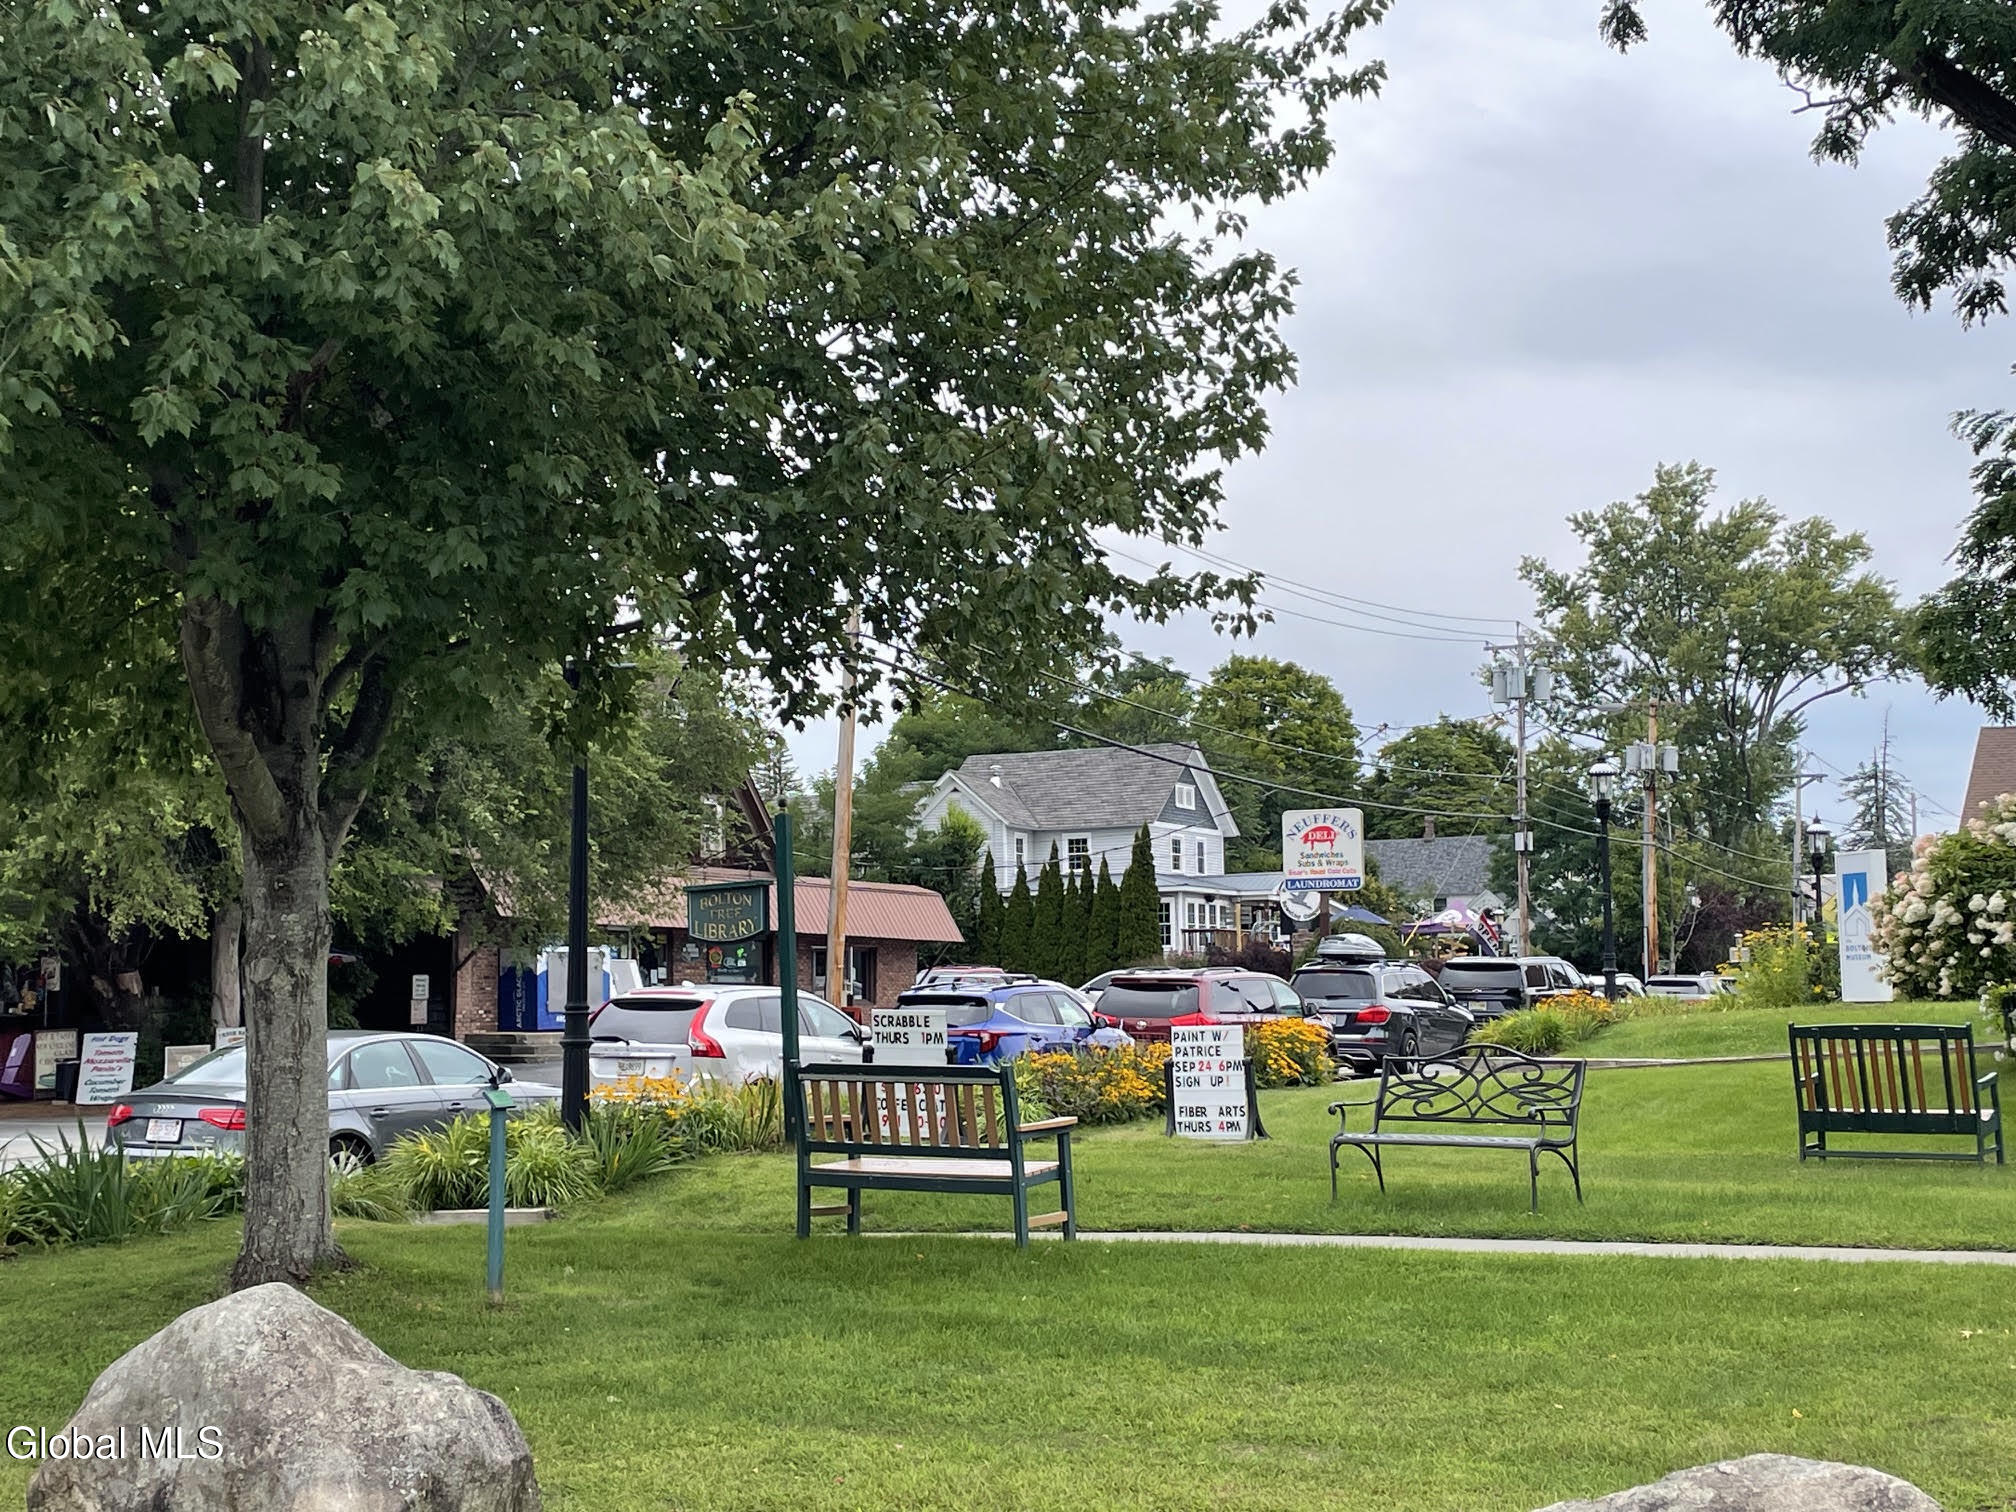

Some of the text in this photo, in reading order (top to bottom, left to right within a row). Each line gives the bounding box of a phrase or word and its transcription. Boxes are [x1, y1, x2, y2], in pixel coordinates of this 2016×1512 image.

[1308, 830, 1335, 840] DELI
[1300, 851, 1344, 859] Sandwiches
[1326, 860, 1349, 868] Wraps
[1287, 878, 1360, 889] LAUNDROMAT
[700, 891, 752, 910] BOLTON
[710, 907, 742, 920] FREE
[694, 918, 755, 940] LIBRARY
[873, 1015, 930, 1028] SCRABBLE
[875, 1032, 944, 1044] THURS 1PM
[1173, 1031, 1229, 1042] PAINT W/
[1175, 1046, 1221, 1057] PATRICE
[1175, 1061, 1242, 1072] SEP 24 6PM
[1175, 1076, 1200, 1088] SIGN
[1179, 1106, 1245, 1118] FIBER ARTS
[1177, 1121, 1241, 1132] THURS 4PM
